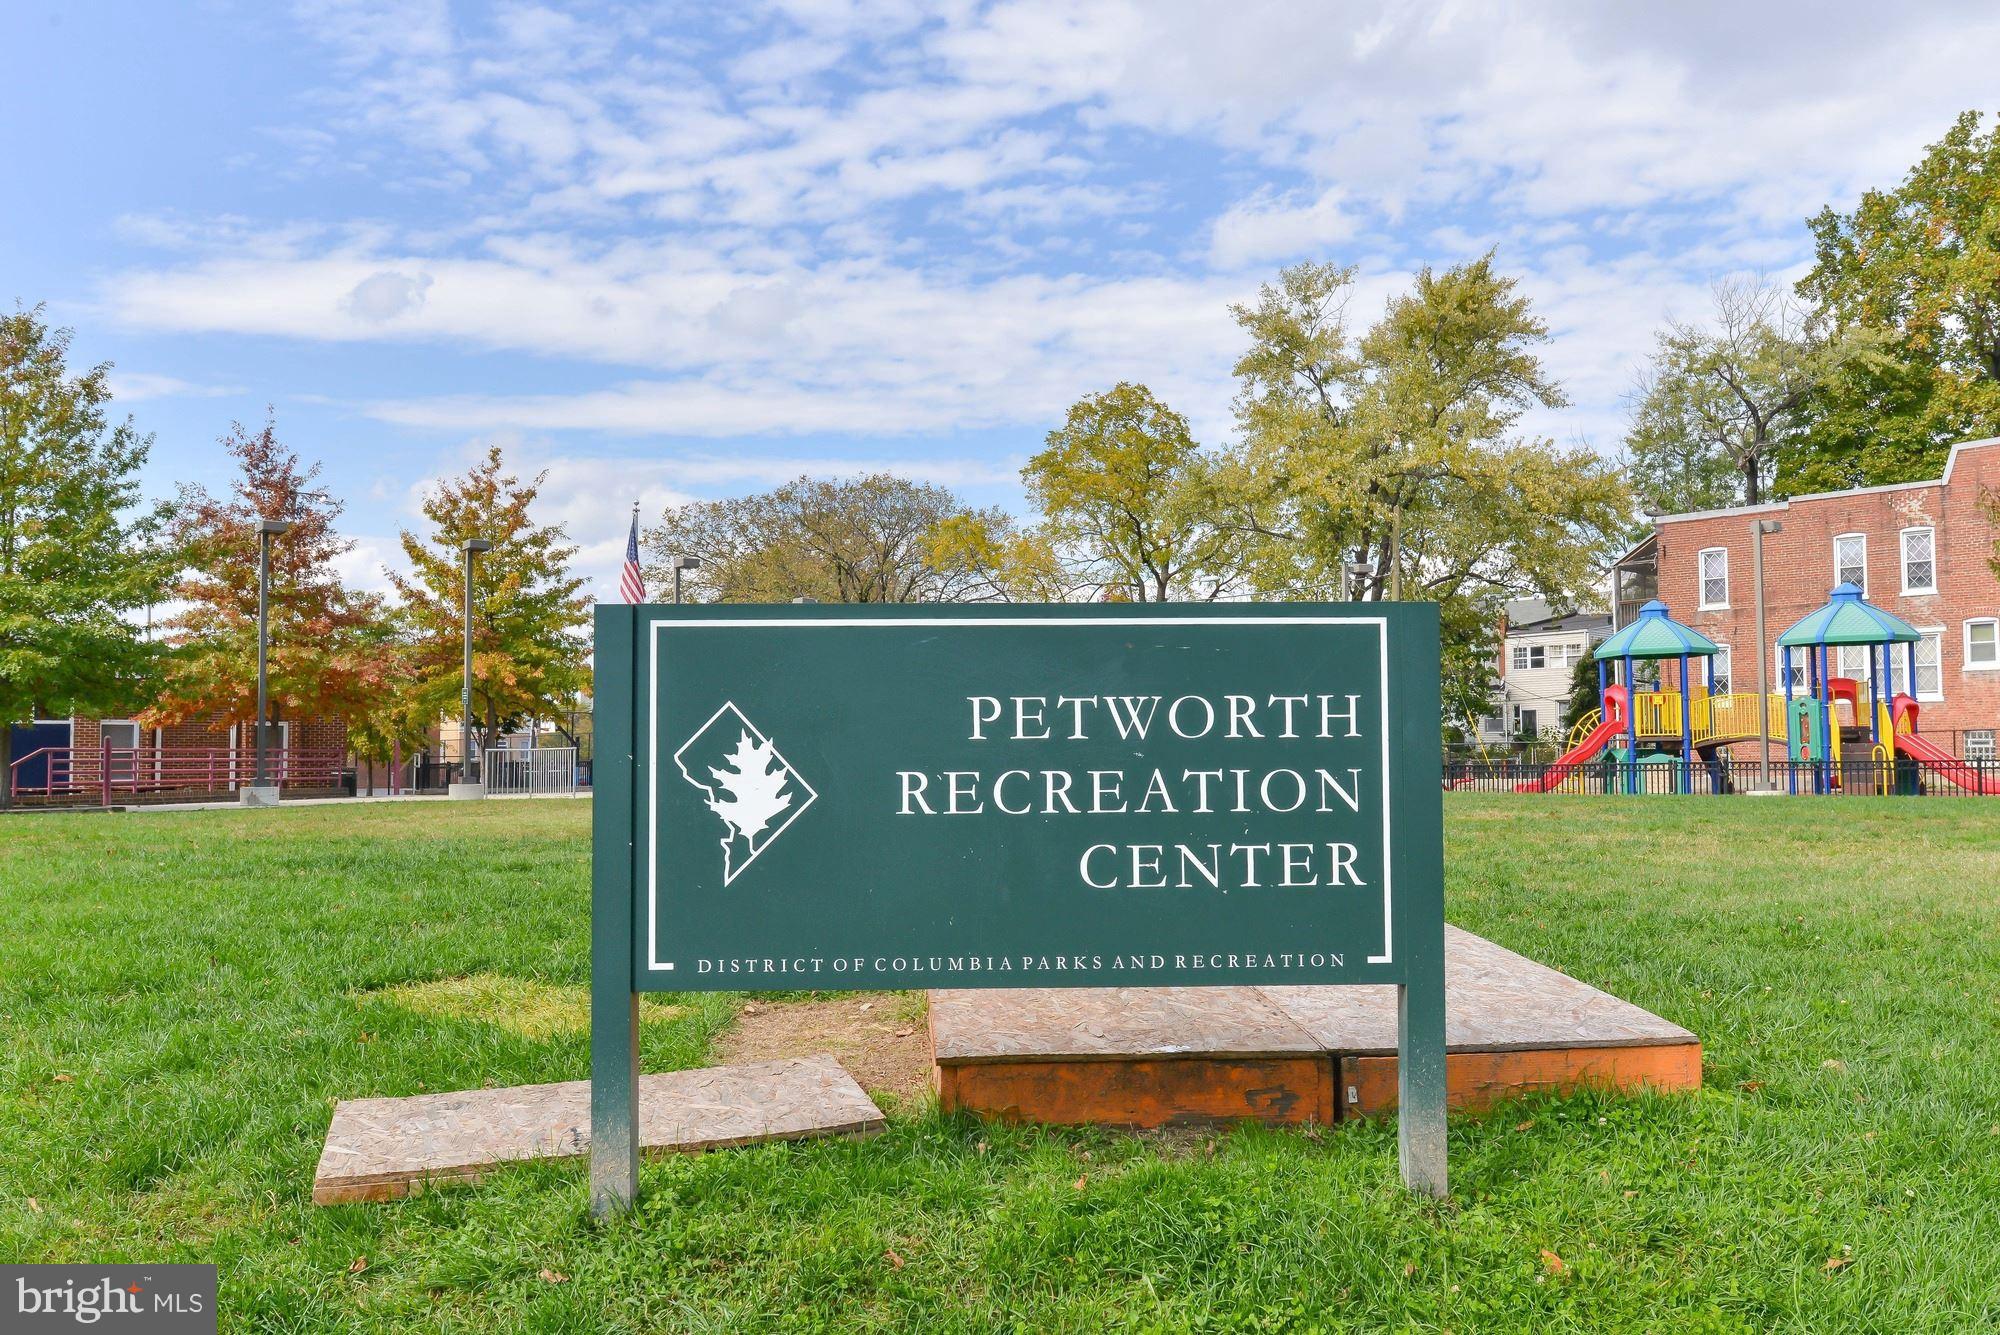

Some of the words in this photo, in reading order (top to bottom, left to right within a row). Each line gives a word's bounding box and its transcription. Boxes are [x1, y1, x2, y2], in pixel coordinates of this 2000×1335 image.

[967, 694, 1362, 740] PETWORTH
[896, 768, 1362, 815] RECREATION
[1080, 841, 1367, 889] CENTER
[697, 958, 824, 973] DISTRICT
[833, 957, 865, 972] OF
[874, 956, 1012, 972] COLUMBIA
[1022, 955, 1102, 970] PARKS
[1112, 955, 1165, 969] AND
[1175, 953, 1344, 969] RECREATION
